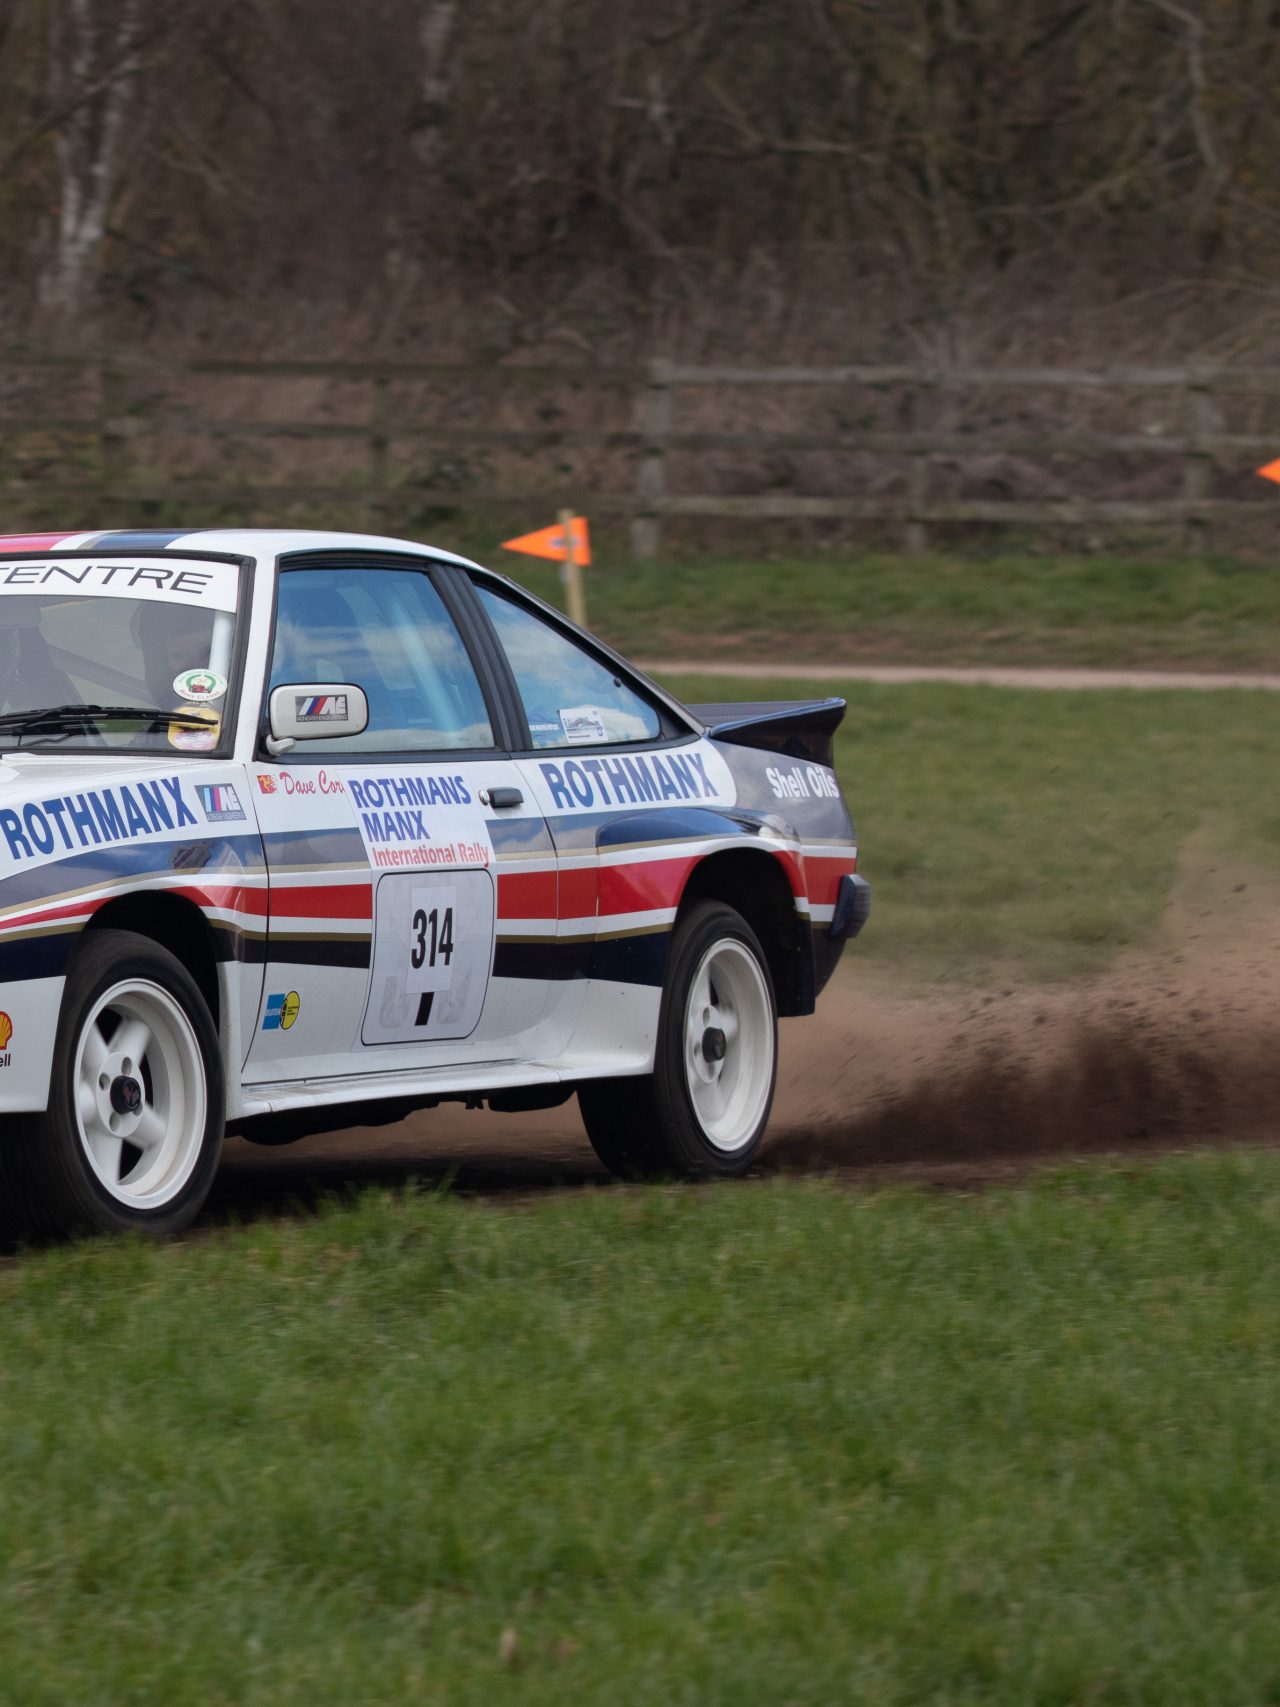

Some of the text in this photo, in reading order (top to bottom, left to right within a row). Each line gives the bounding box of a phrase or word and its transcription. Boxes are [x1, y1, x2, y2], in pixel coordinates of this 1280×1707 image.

[278, 771, 317, 795] Dave
[346, 775, 472, 808] ROTHMANS
[538, 752, 719, 809] ROTHMANX
[765, 766, 840, 799] Shell Oils
[361, 809, 432, 843] MANX
[371, 842, 490, 868] International Rally
[410, 907, 454, 970] 314
